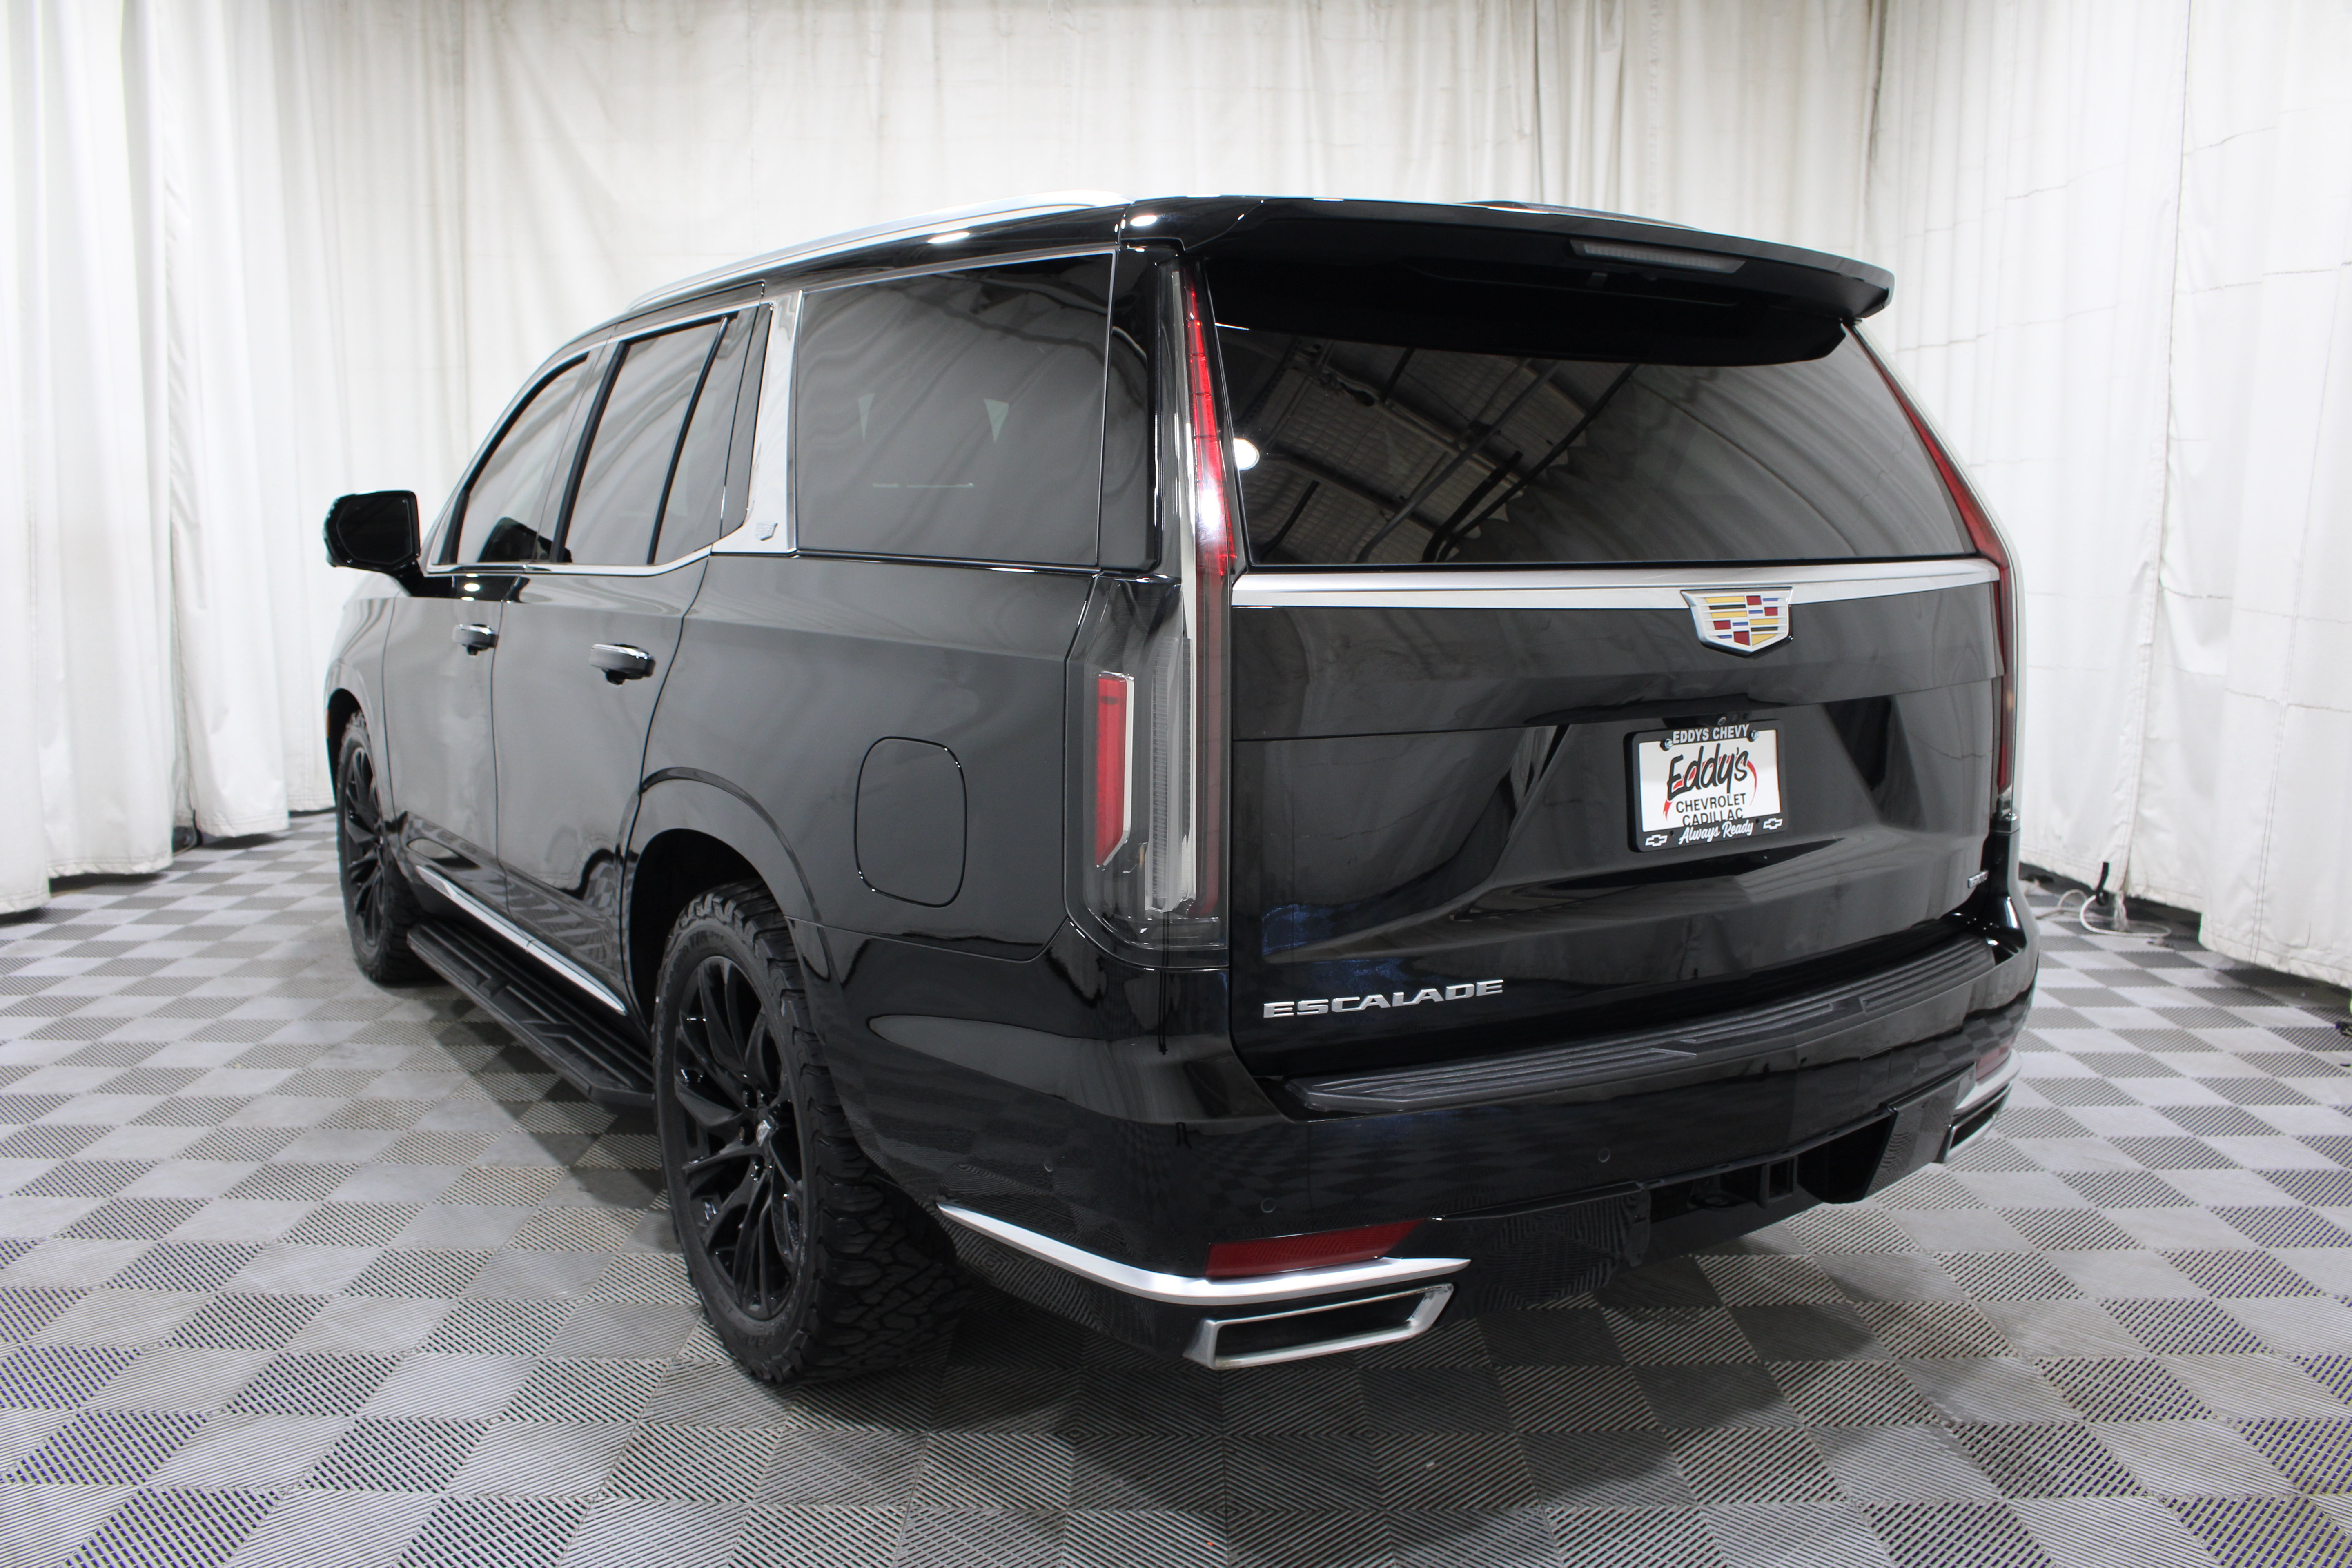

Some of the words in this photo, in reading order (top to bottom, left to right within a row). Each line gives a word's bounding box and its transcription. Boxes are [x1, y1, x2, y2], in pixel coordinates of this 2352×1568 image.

[1673, 728, 1709, 744] EDDYS
[1712, 724, 1750, 740] CHEVY
[1667, 743, 1749, 801] Eddy's
[1676, 793, 1746, 813] CHEVROLET
[1682, 807, 1743, 826] CADILLAC
[1678, 826, 1721, 845] Always
[1721, 819, 1754, 838] Ready
[1263, 979, 1504, 1018] ESCALADE
